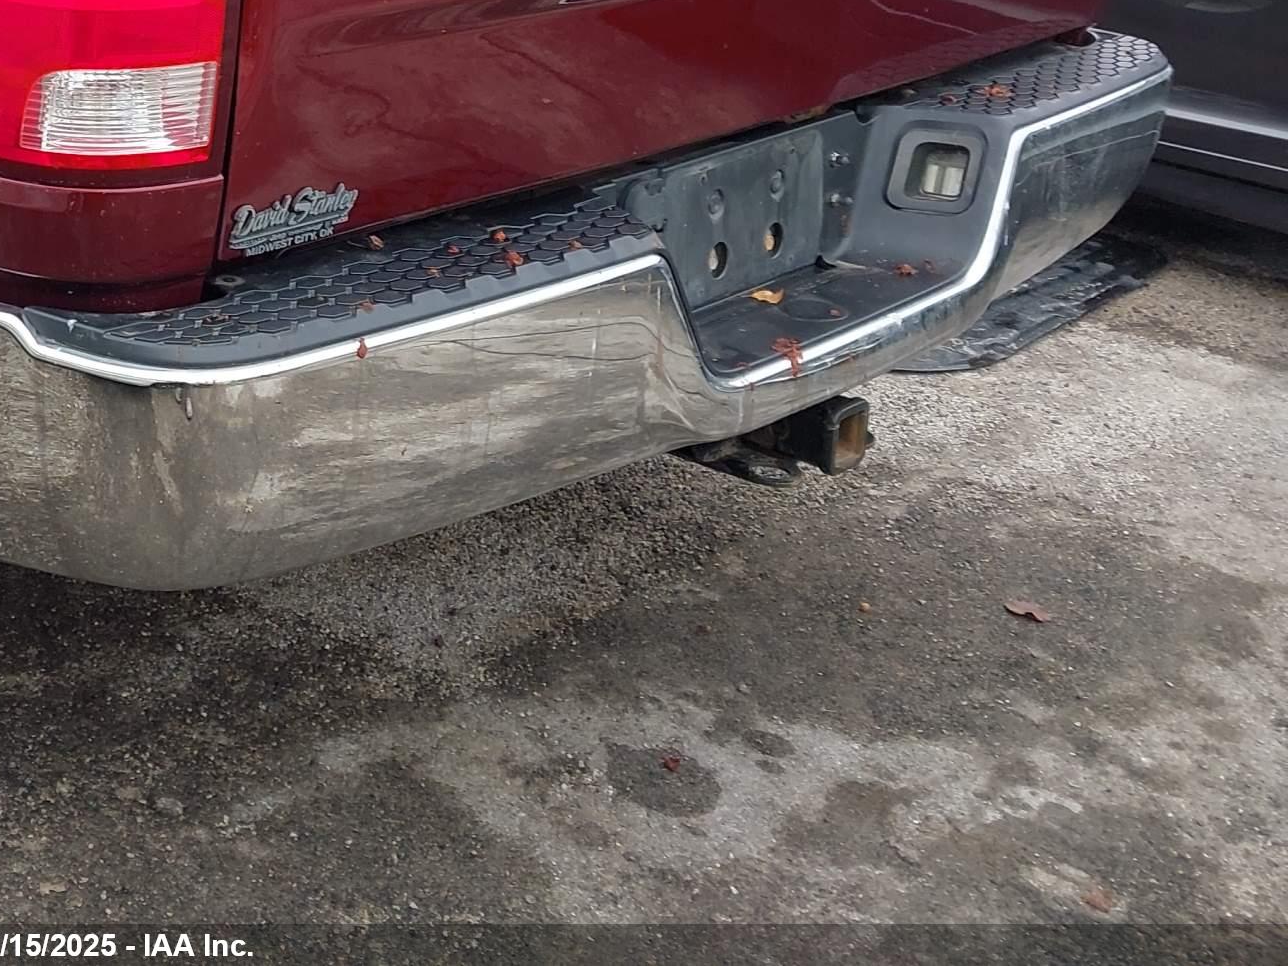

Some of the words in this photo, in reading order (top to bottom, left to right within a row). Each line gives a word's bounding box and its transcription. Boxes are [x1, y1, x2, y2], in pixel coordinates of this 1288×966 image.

[230, 194, 292, 236] David
[289, 183, 359, 225] Stanley
[245, 237, 294, 257] MIDWEST
[319, 226, 334, 238] OK
